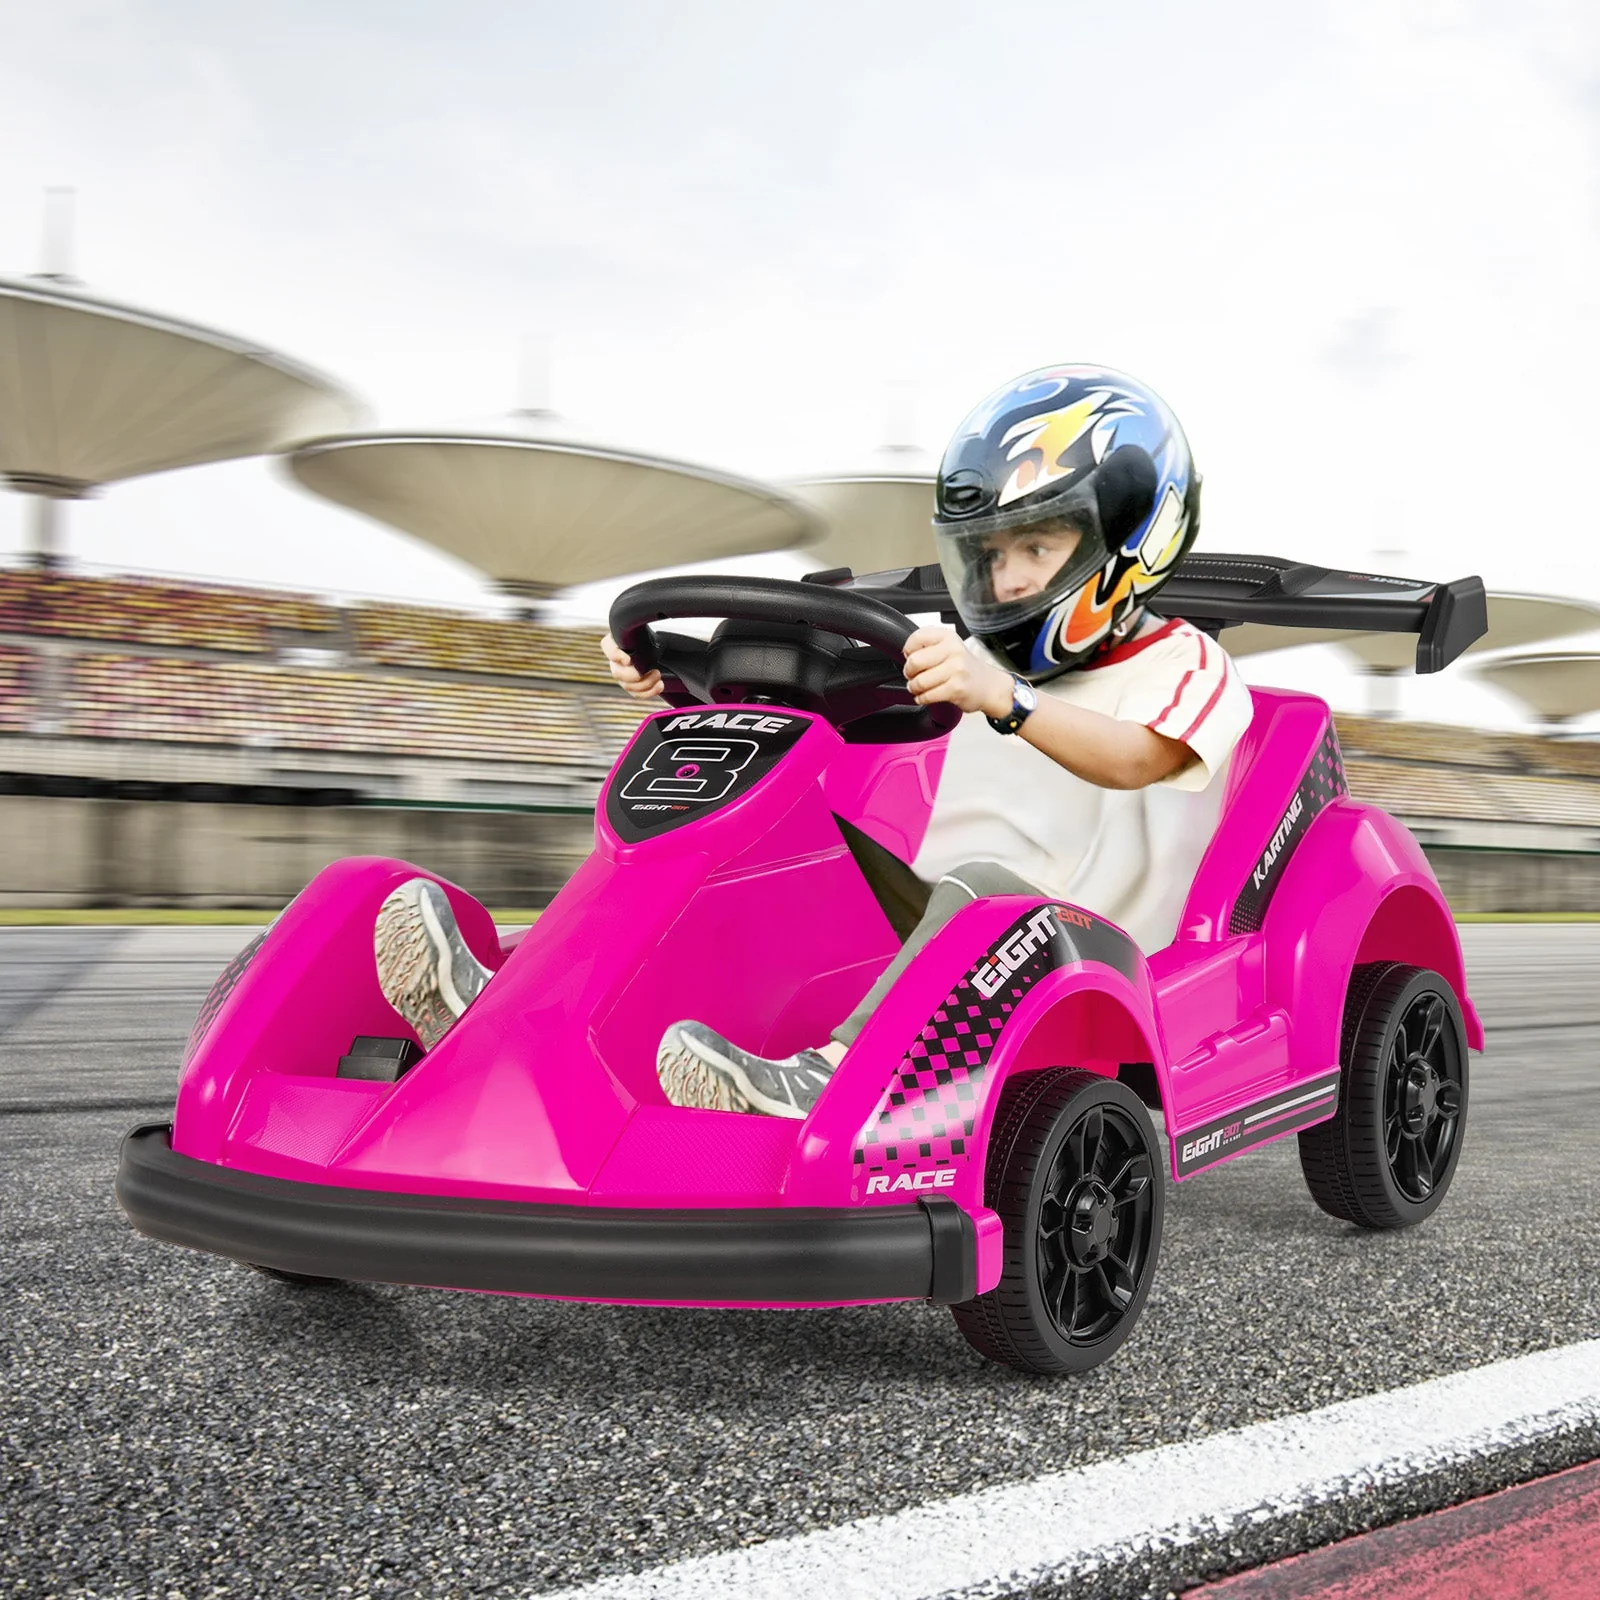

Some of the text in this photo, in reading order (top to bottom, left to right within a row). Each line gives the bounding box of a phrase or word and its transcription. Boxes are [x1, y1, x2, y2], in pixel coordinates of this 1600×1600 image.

[662, 713, 793, 734] RACE
[620, 738, 760, 802] 8
[1253, 792, 1303, 890] KARTING
[866, 1169, 957, 1194] RACE
